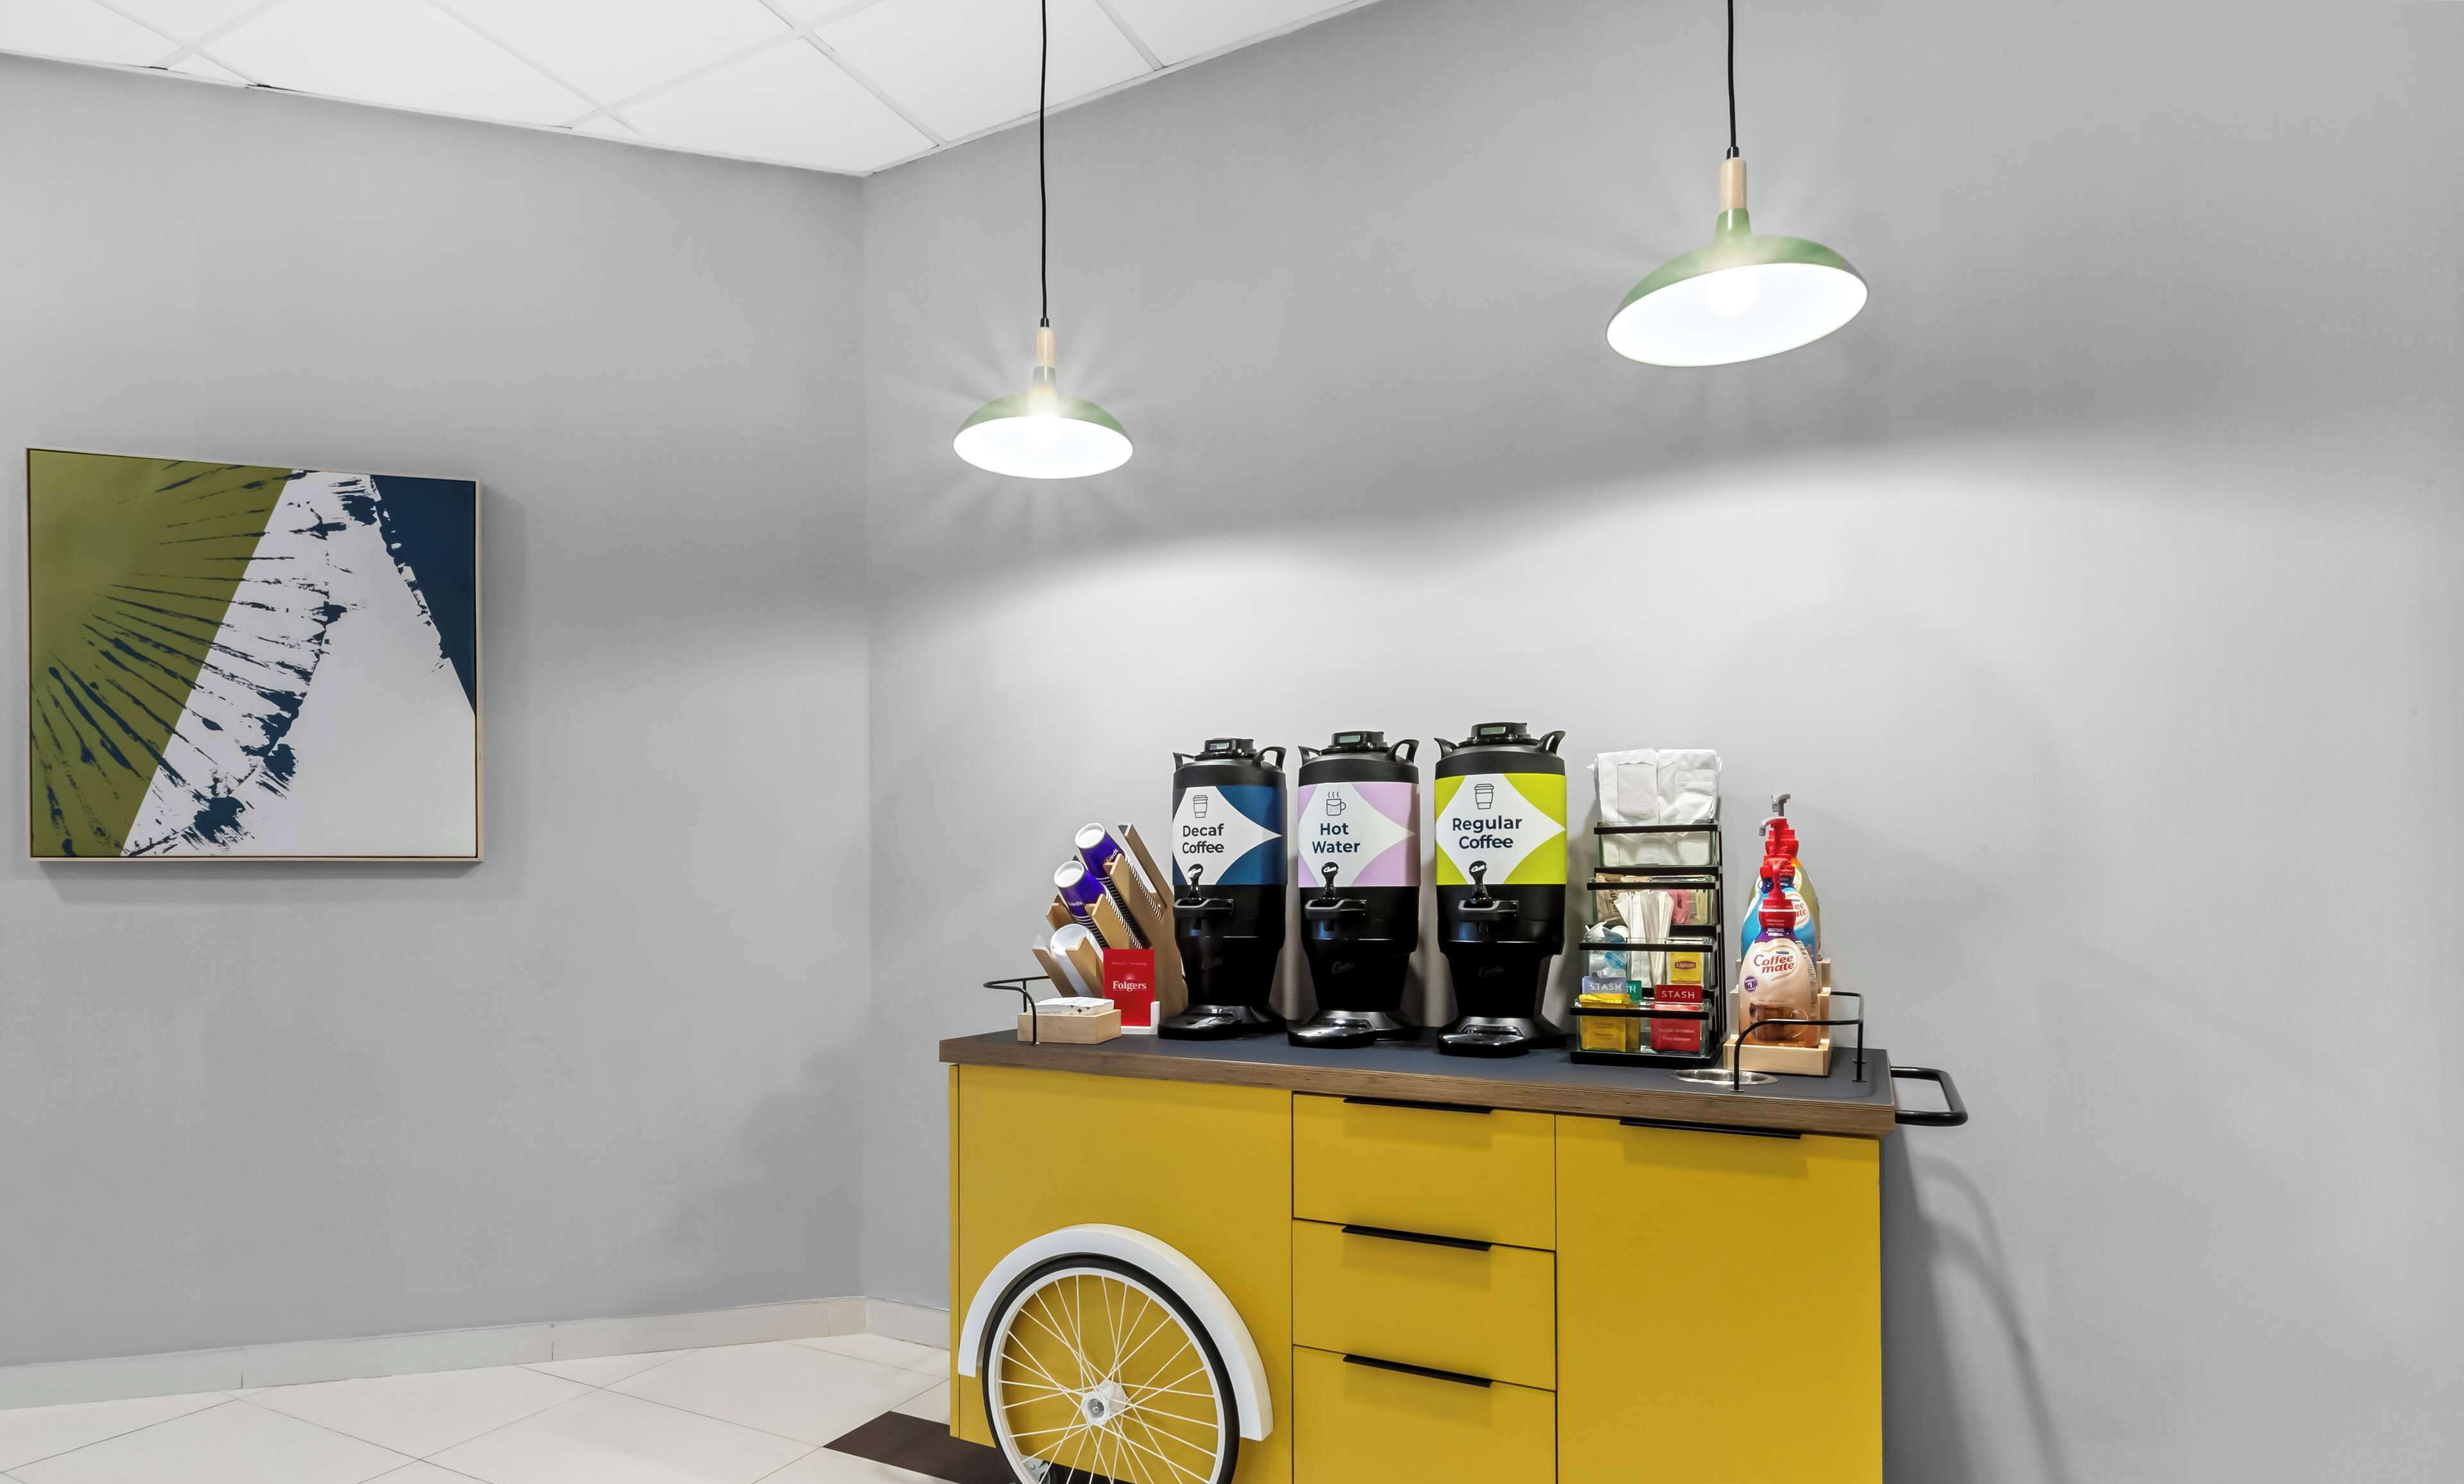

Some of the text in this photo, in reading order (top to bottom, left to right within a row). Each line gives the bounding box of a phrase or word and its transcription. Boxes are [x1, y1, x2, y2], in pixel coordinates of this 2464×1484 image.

[1183, 823, 1224, 837] Decaf
[1320, 823, 1349, 836] Hot
[1452, 815, 1523, 833] Regular
[1182, 840, 1224, 854] Coffee
[1312, 840, 1360, 853] Water
[1459, 834, 1514, 849] Coffee
[1754, 954, 1793, 966] Coffee
[1762, 962, 1795, 973] mate
[1112, 980, 1147, 992] Folgers
[1589, 982, 1622, 991] STASH
[1661, 990, 1695, 999] STASH
